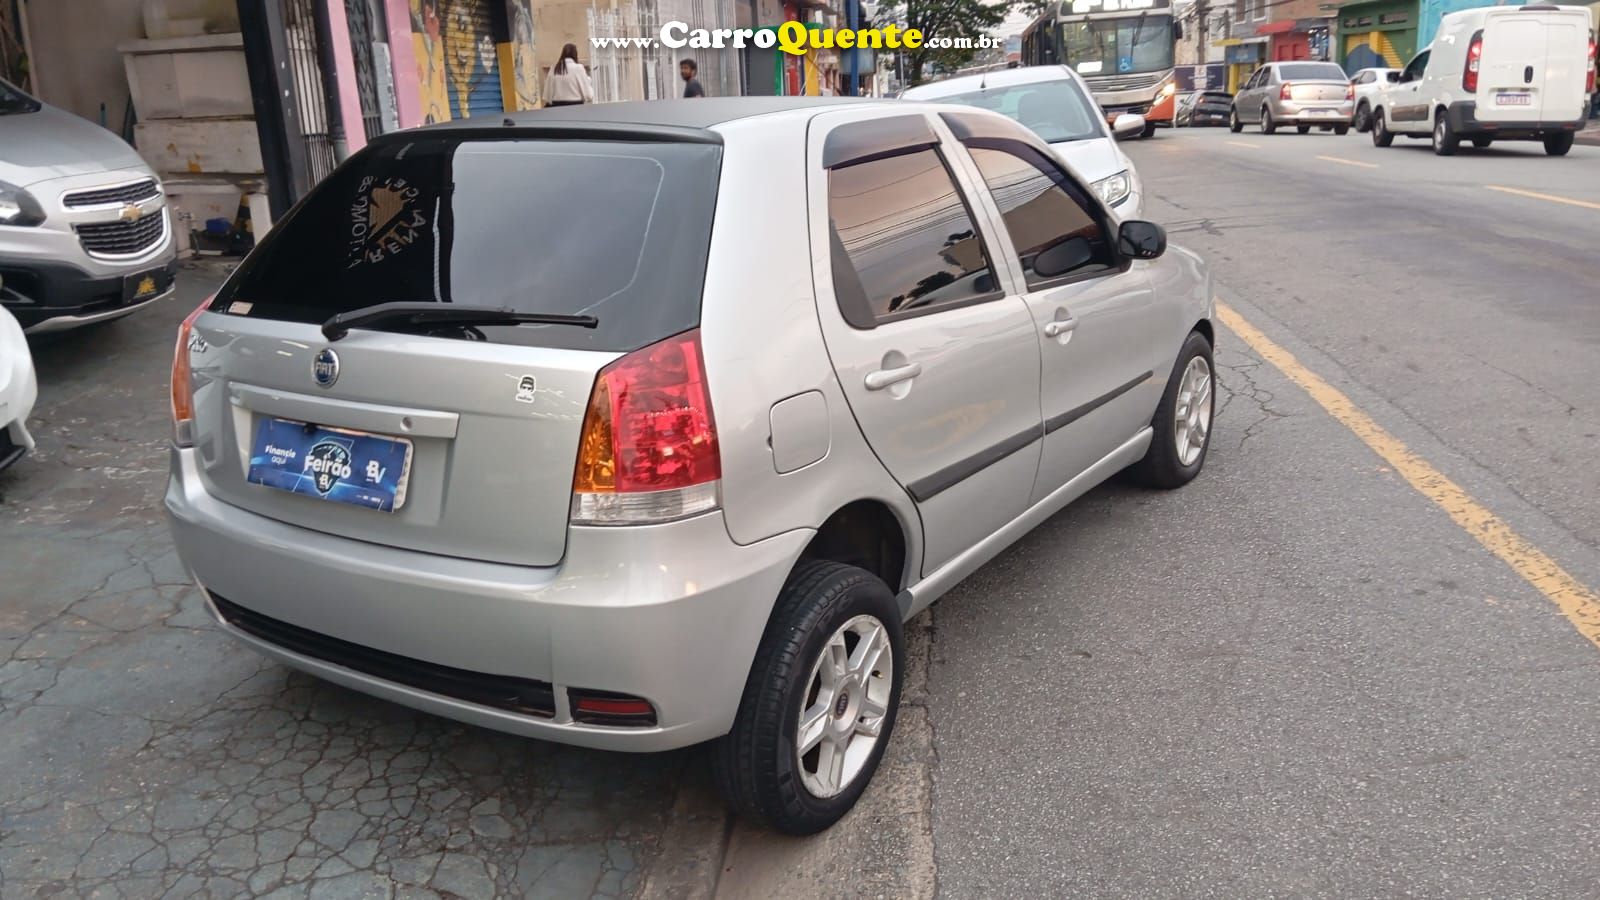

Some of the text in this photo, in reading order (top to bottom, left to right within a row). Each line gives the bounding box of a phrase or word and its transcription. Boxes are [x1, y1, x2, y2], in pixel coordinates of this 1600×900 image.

[265, 444, 297, 459] Financie
[271, 456, 288, 466] aqui
[303, 453, 352, 479] Feirão
